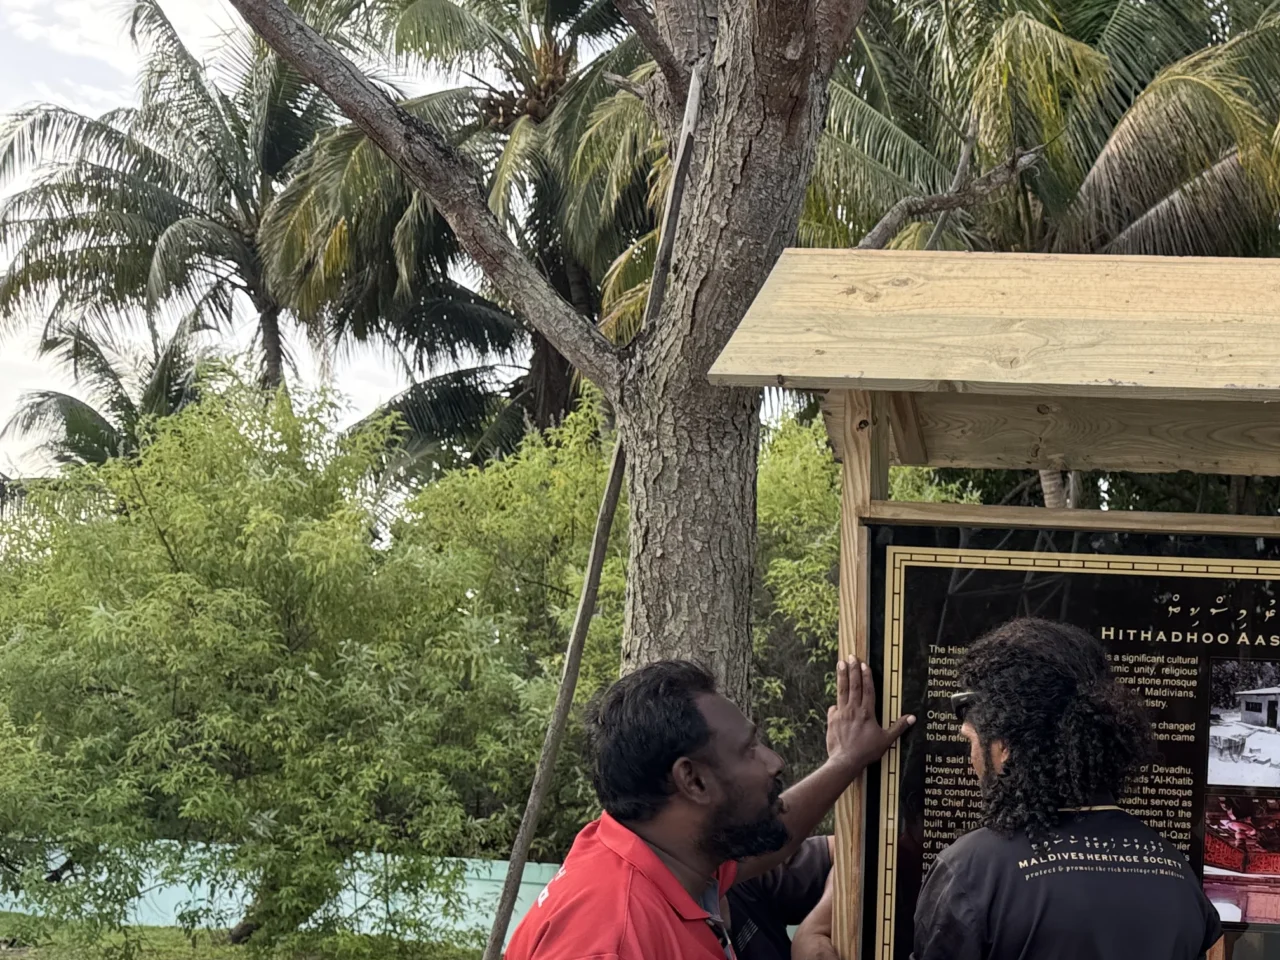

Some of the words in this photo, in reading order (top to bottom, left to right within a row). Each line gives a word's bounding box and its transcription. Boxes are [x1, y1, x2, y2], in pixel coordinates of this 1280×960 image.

[1102, 627, 1229, 644] HITHADHOO
[929, 645, 945, 653] The
[948, 646, 968, 655] Hist
[1122, 654, 1164, 664] significant
[1167, 656, 1198, 664] cultural
[928, 667, 960, 678] heritag
[1115, 676, 1136, 685] coral
[1138, 677, 1161, 685] stone
[1163, 679, 1197, 688] mosque
[1134, 666, 1156, 676] unity,
[1162, 667, 1197, 676] religious
[1145, 687, 1196, 698] Maldivians,
[927, 722, 946, 730] after
[1158, 721, 1195, 732] changed
[936, 733, 947, 741] be
[926, 754, 931, 762] It
[935, 755, 942, 763] is
[946, 756, 964, 764] said
[1153, 764, 1193, 774] Devadhu.
[926, 765, 964, 775] However,
[925, 776, 955, 785] al-Qazi
[1143, 786, 1156, 794] the
[1158, 789, 1192, 797] mosque
[925, 798, 938, 806] the
[942, 798, 964, 807] Chief
[1166, 809, 1174, 817] to
[1178, 810, 1191, 818] the
[924, 809, 953, 817] throne.
[1168, 820, 1172, 828] it
[924, 819, 942, 827] built
[1018, 852, 1085, 869] MALDIVES
[1086, 852, 1140, 863] HERITAGE
[1143, 855, 1182, 869] SOCIETY
[1025, 867, 1056, 881] protect
[1066, 864, 1095, 873] promote
[1095, 864, 1107, 872] the
[1122, 867, 1150, 876] heritage
